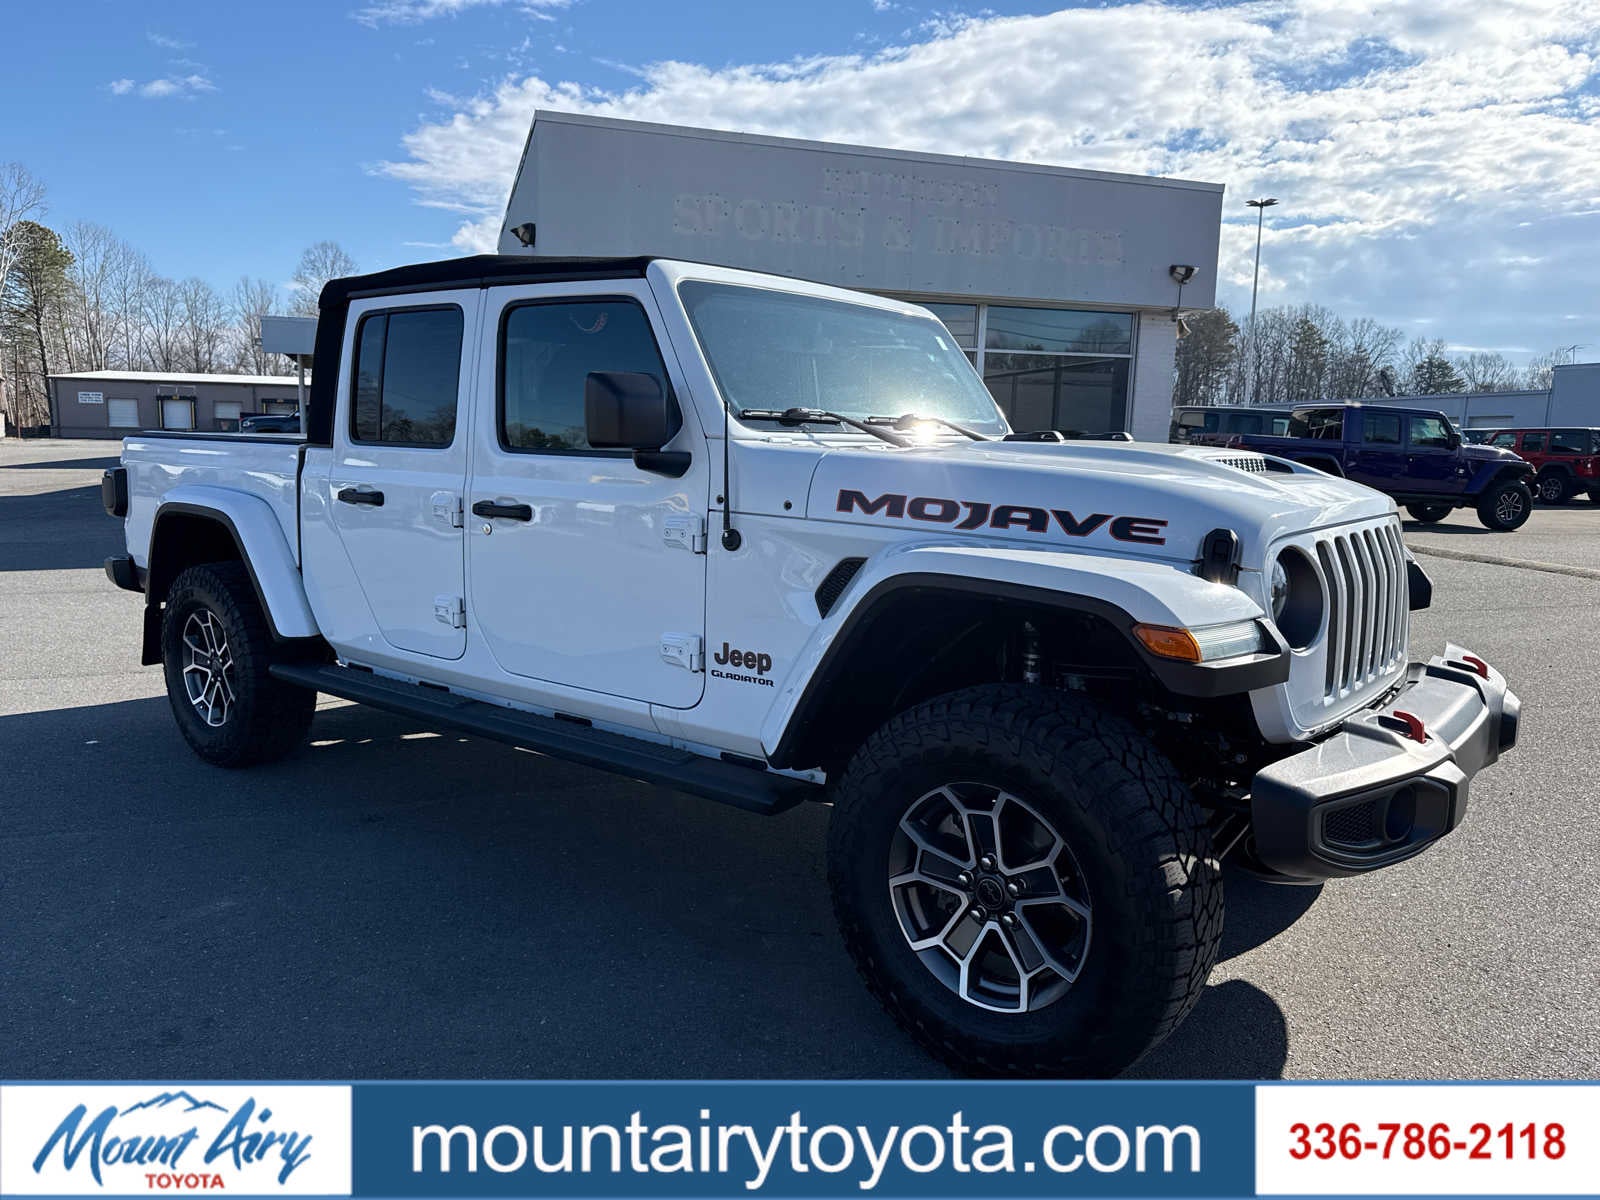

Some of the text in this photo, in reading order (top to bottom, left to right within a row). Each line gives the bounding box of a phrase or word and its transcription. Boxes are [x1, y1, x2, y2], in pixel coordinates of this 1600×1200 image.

[673, 191, 1126, 266] SPORTS & IMPORTS
[836, 489, 1168, 545] MOJAVE
[711, 669, 775, 687] GLADIATOR
[714, 642, 772, 675] Jeep
